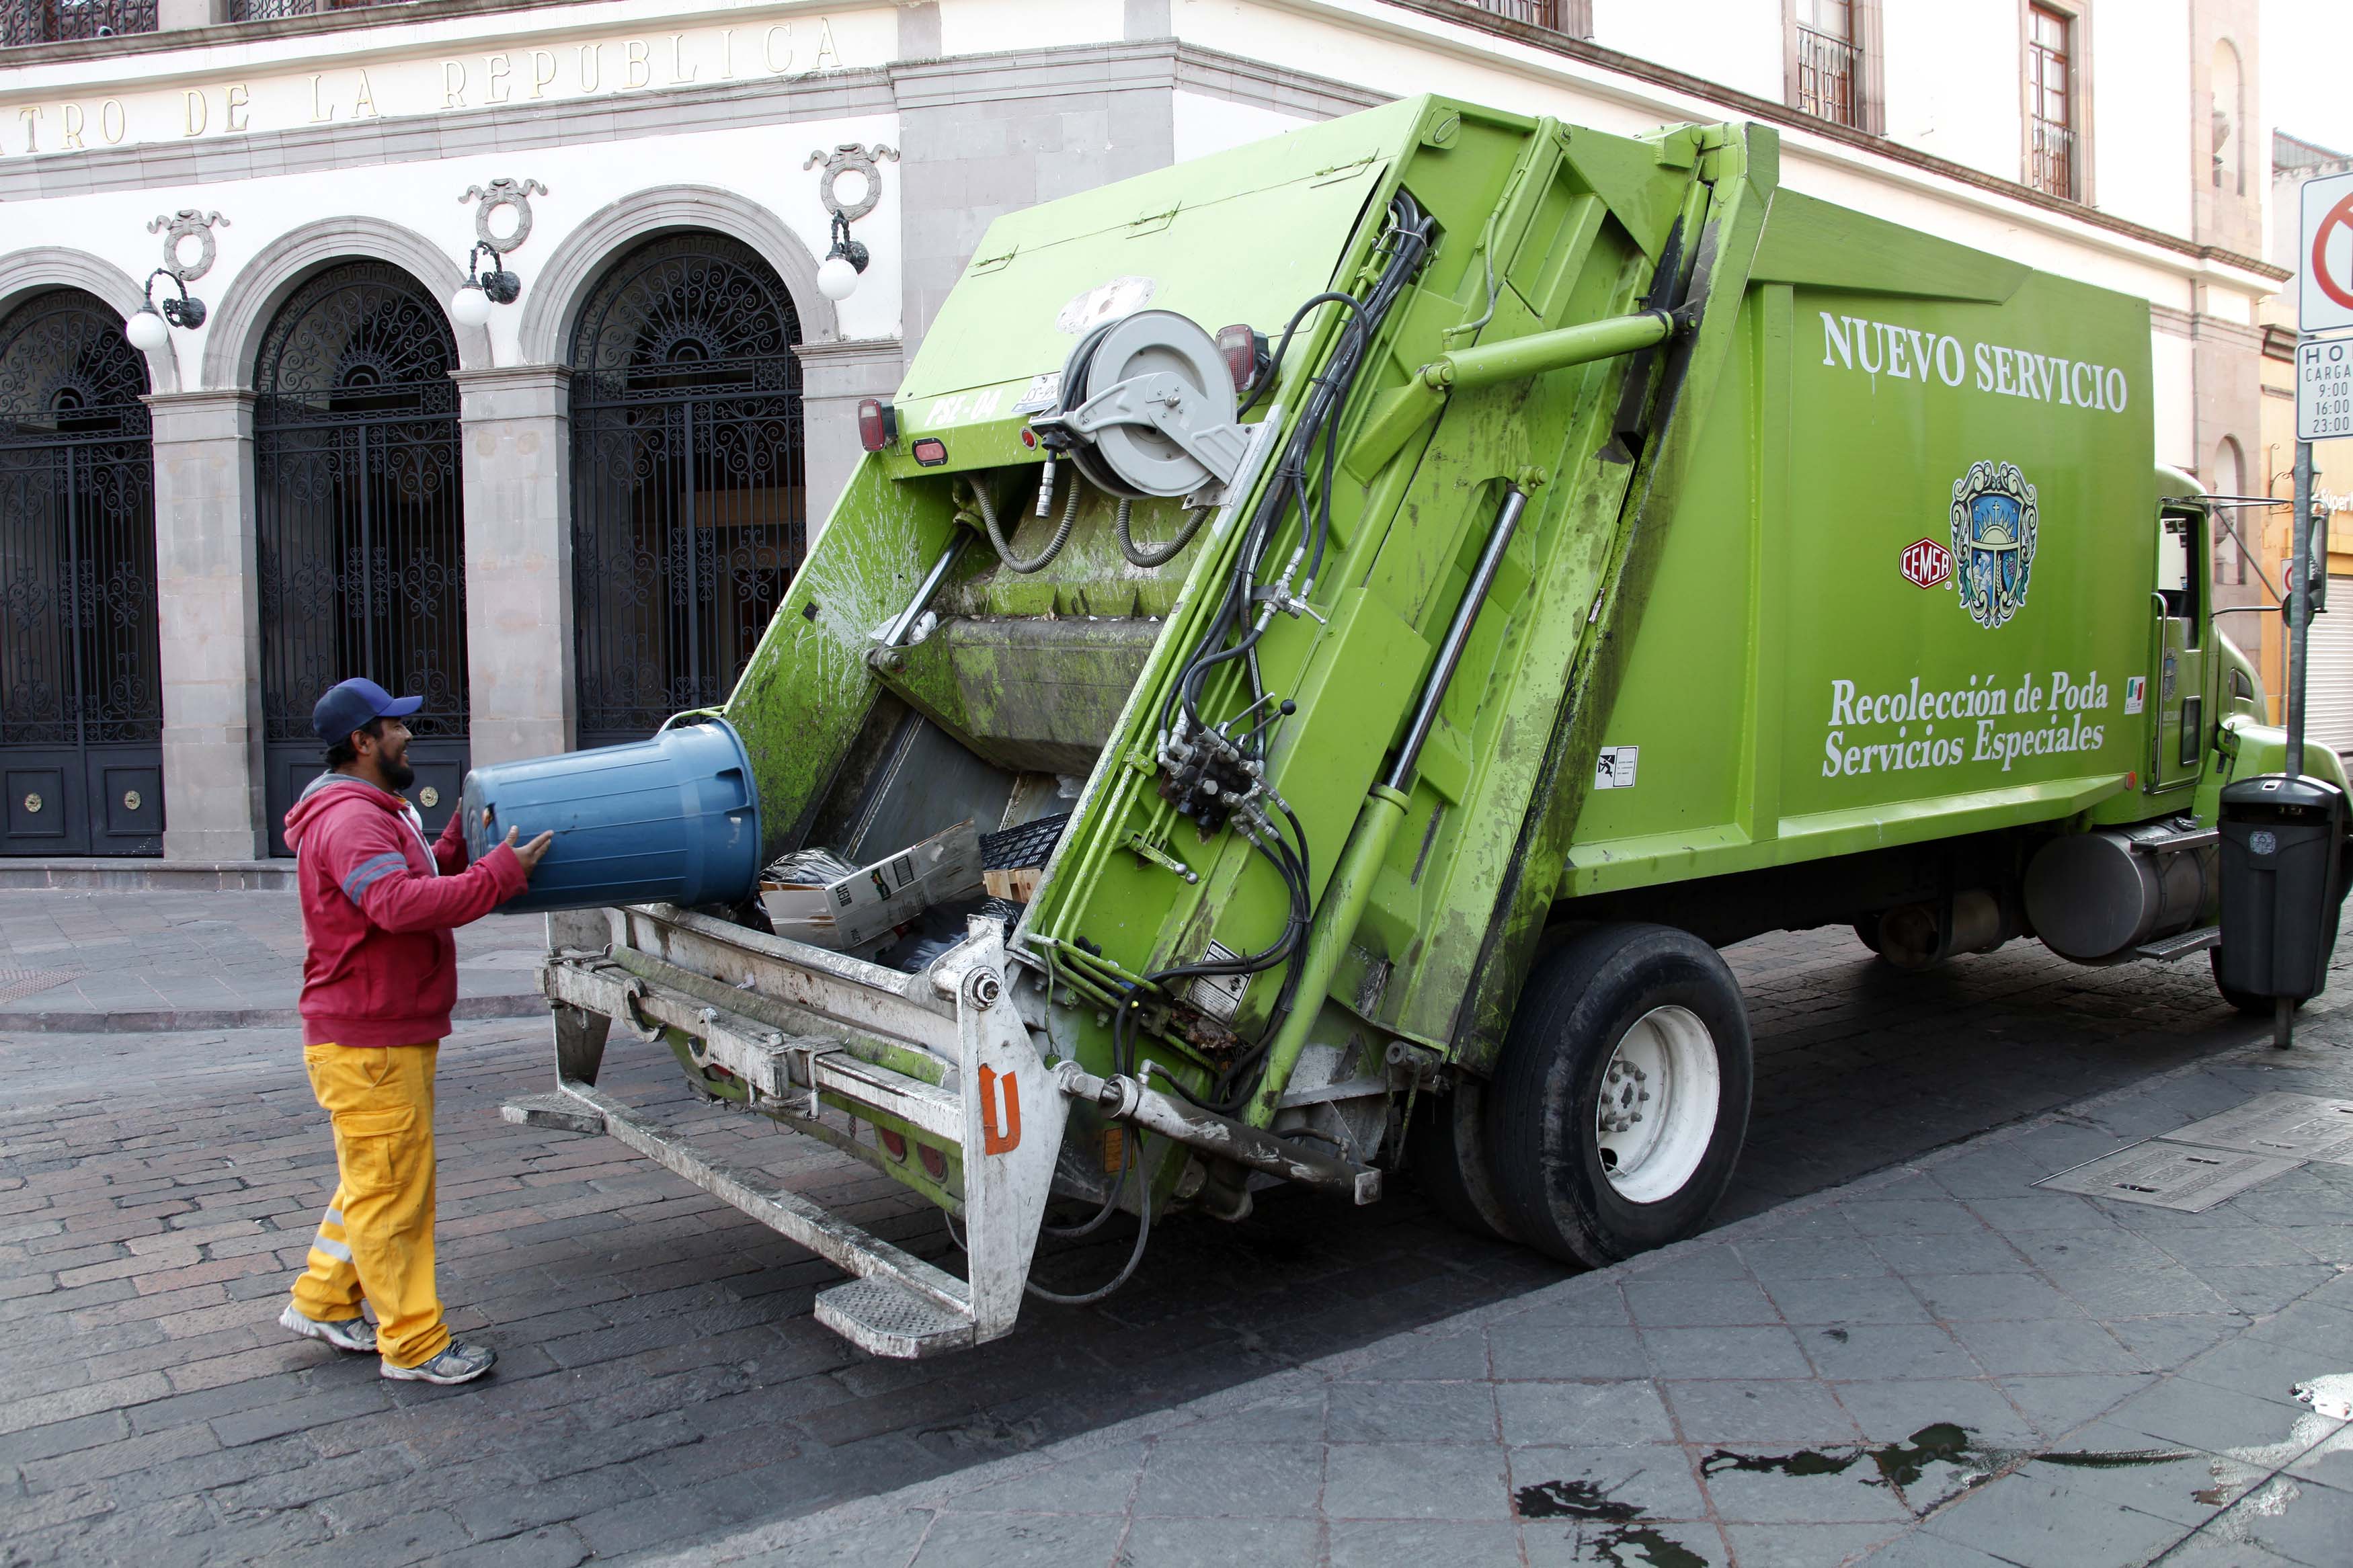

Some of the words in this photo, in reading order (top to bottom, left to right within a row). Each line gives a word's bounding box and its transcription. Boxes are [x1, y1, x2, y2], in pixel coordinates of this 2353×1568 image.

[0, 99, 126, 155] TRO
[181, 83, 249, 137] DE
[307, 69, 378, 124] LA
[438, 17, 843, 110] REPUBLICA
[1819, 311, 1965, 386] NUEVO
[1975, 343, 2127, 413] SERVICIO
[2305, 344, 2353, 365] HO
[2306, 364, 2351, 382] CARGA
[924, 388, 1003, 427] PSE-04
[2315, 399, 2349, 415] 16:00
[2319, 382, 2348, 397] 9:00
[2313, 416, 2349, 433] 23:00
[1903, 545, 1950, 582] CEMSA
[1827, 673, 2007, 727] Recolección
[2013, 672, 2041, 714] de
[2046, 671, 2108, 712] Poda
[1822, 725, 1964, 778] Servicios
[1971, 713, 2105, 772] Especiales
